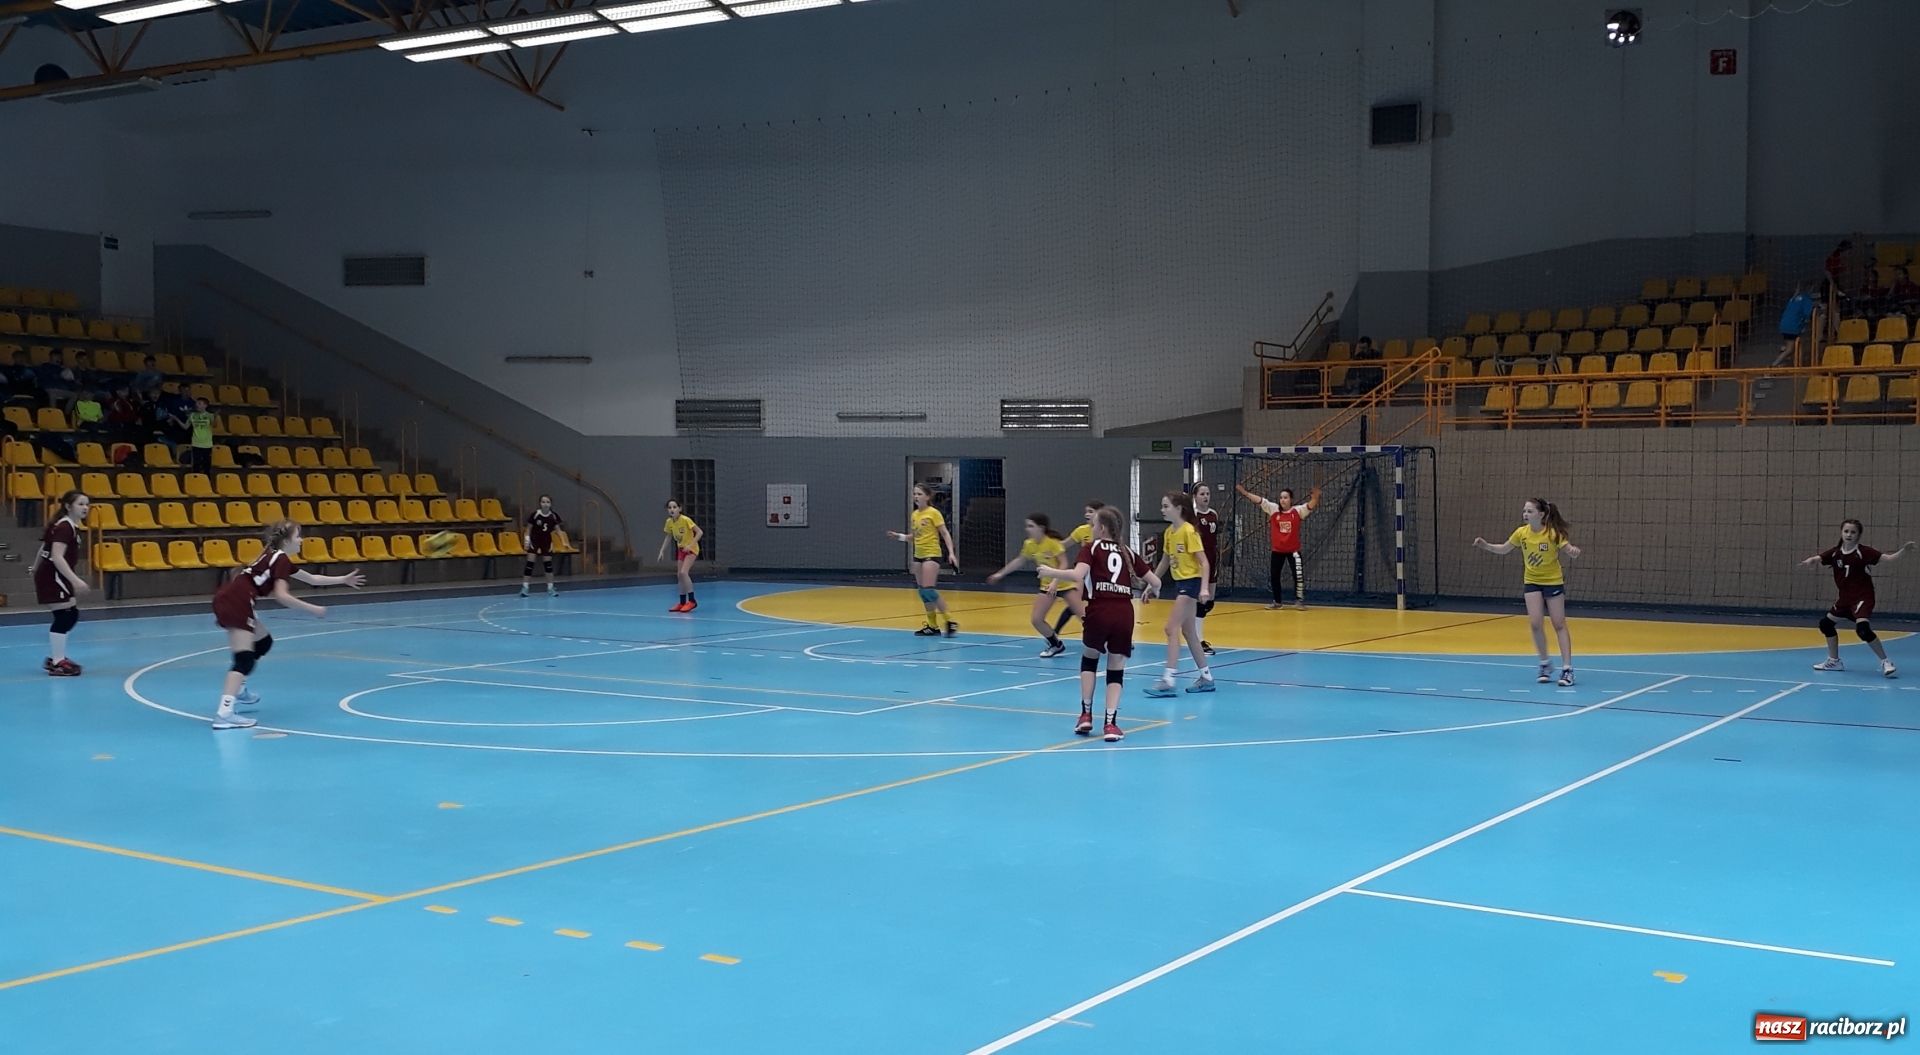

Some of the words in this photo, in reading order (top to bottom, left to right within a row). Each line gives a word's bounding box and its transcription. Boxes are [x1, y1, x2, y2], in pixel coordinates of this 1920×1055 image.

[1718, 57, 1728, 72] F
[542, 523, 548, 532] 5
[1107, 551, 1122, 583] 9
[1844, 565, 1850, 577] 7
